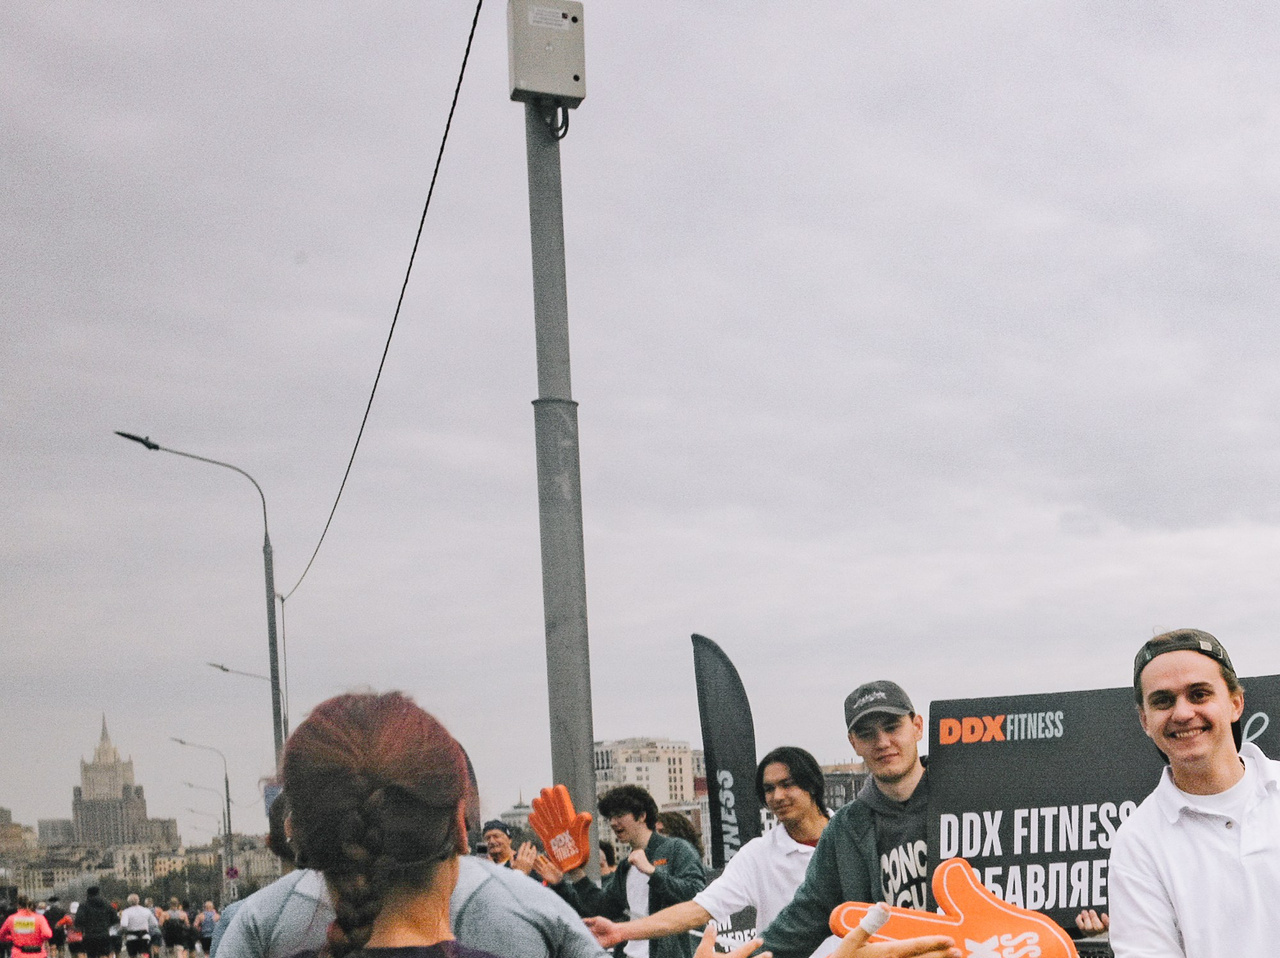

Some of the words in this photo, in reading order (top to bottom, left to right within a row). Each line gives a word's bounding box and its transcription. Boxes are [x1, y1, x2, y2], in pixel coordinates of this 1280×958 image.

[939, 715, 1006, 745] DDX
[1006, 711, 1064, 740] FITNESS
[717, 769, 740, 865] TNESS
[940, 811, 1003, 859] DDX
[937, 859, 1110, 916] БАВЛЯЕ
